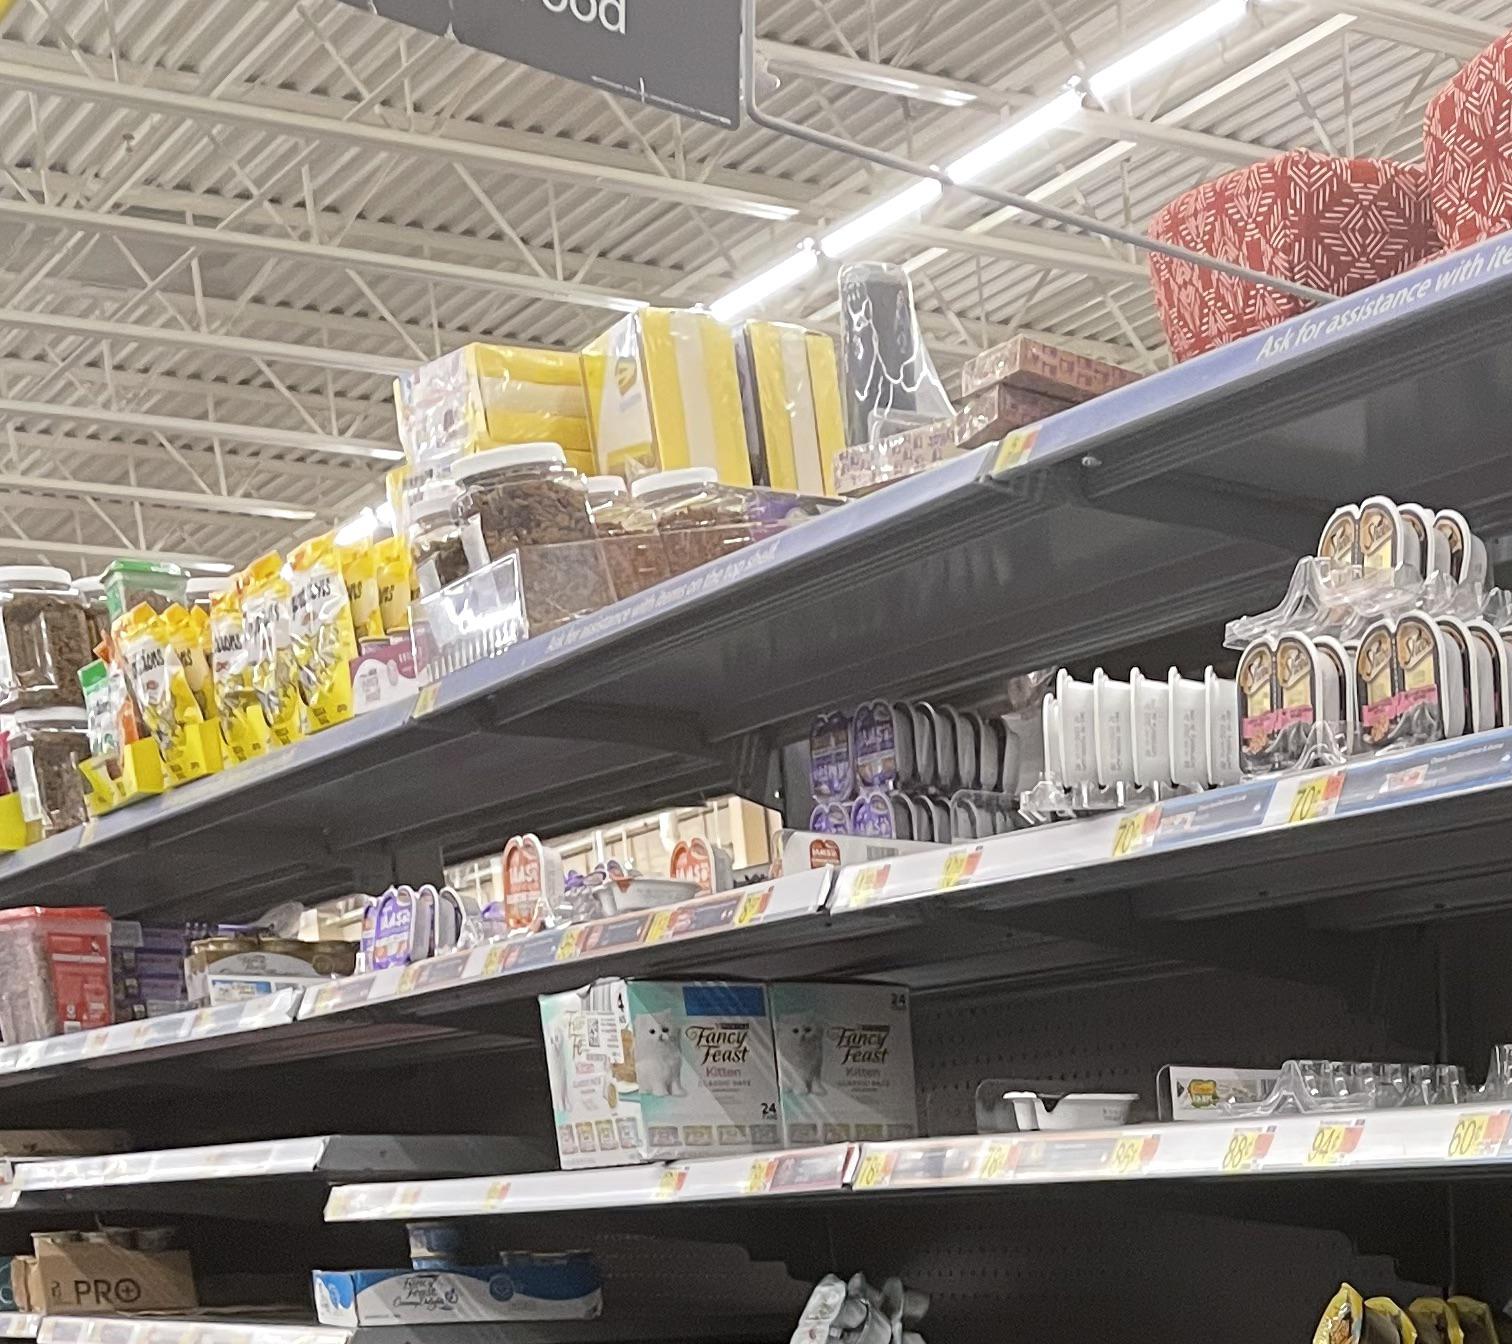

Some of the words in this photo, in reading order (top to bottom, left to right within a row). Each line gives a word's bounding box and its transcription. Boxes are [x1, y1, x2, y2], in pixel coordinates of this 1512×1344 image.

[1256, 332, 1291, 361] Ask
[1292, 313, 1326, 352] for
[1323, 278, 1434, 334] assistance
[1434, 254, 1486, 294] with
[684, 1024, 748, 1049] Fancy
[828, 1026, 888, 1049] Fancy
[701, 1045, 750, 1066] Feast
[840, 1045, 889, 1065] Feast
[705, 1067, 741, 1079] Kitten
[761, 1102, 777, 1116] 24
[1308, 1126, 1341, 1164] 94¢
[1448, 1119, 1482, 1156] 60¢
[1223, 1135, 1250, 1169] 88¢
[74, 1278, 142, 1305] PRO
